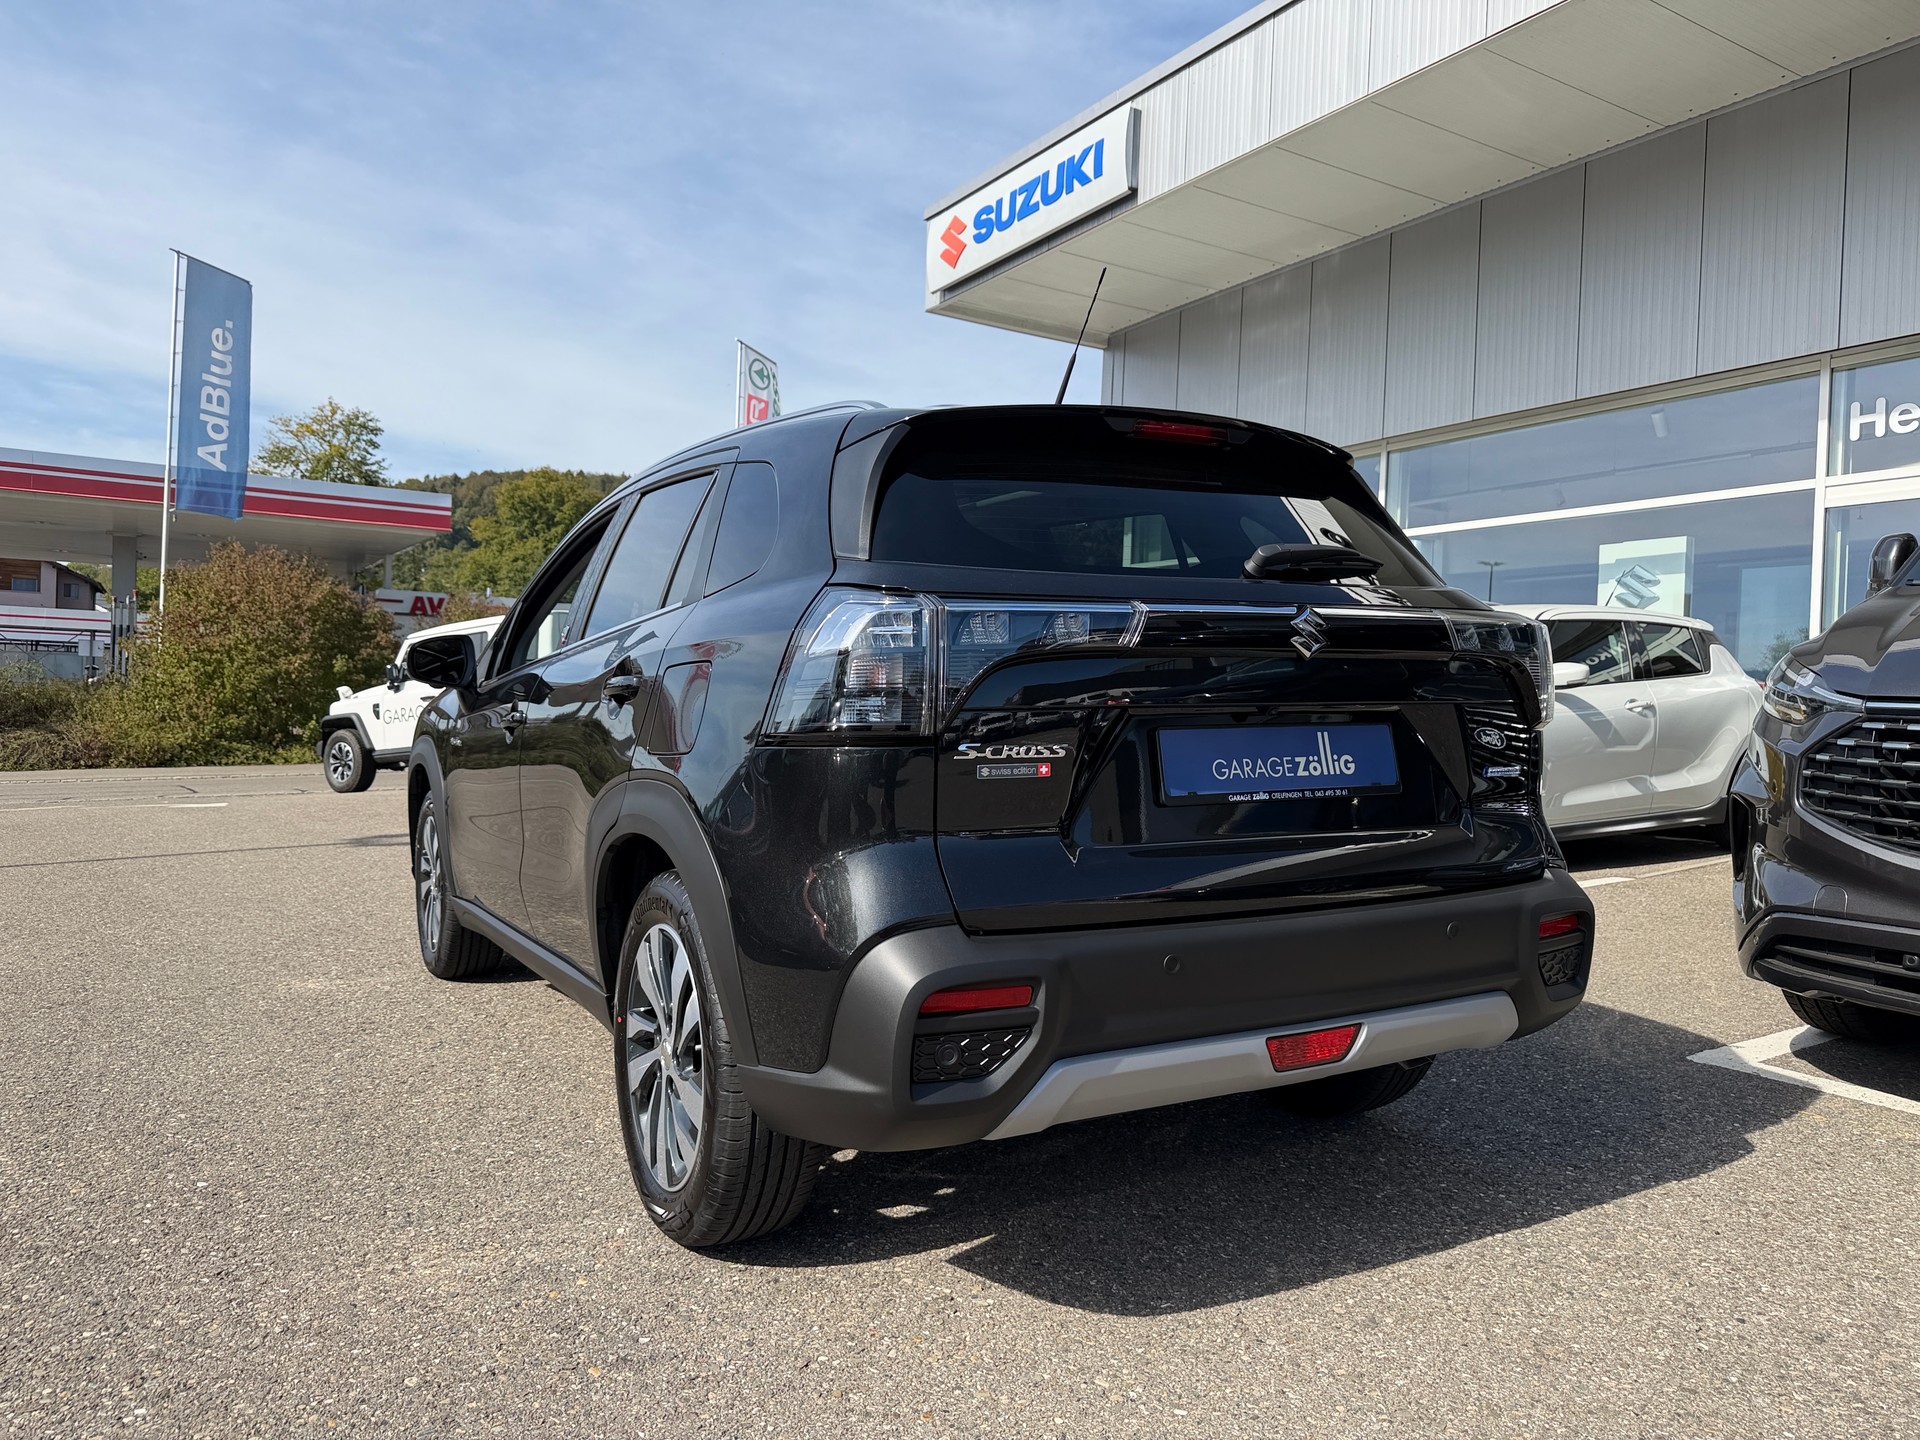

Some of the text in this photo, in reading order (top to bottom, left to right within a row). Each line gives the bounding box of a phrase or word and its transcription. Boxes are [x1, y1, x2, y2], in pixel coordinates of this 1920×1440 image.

[972, 137, 1105, 244] SUZUKI
[1849, 397, 1920, 441] He
[990, 766, 1037, 776] swiss edition
[1228, 794, 1252, 802] GARAGE
